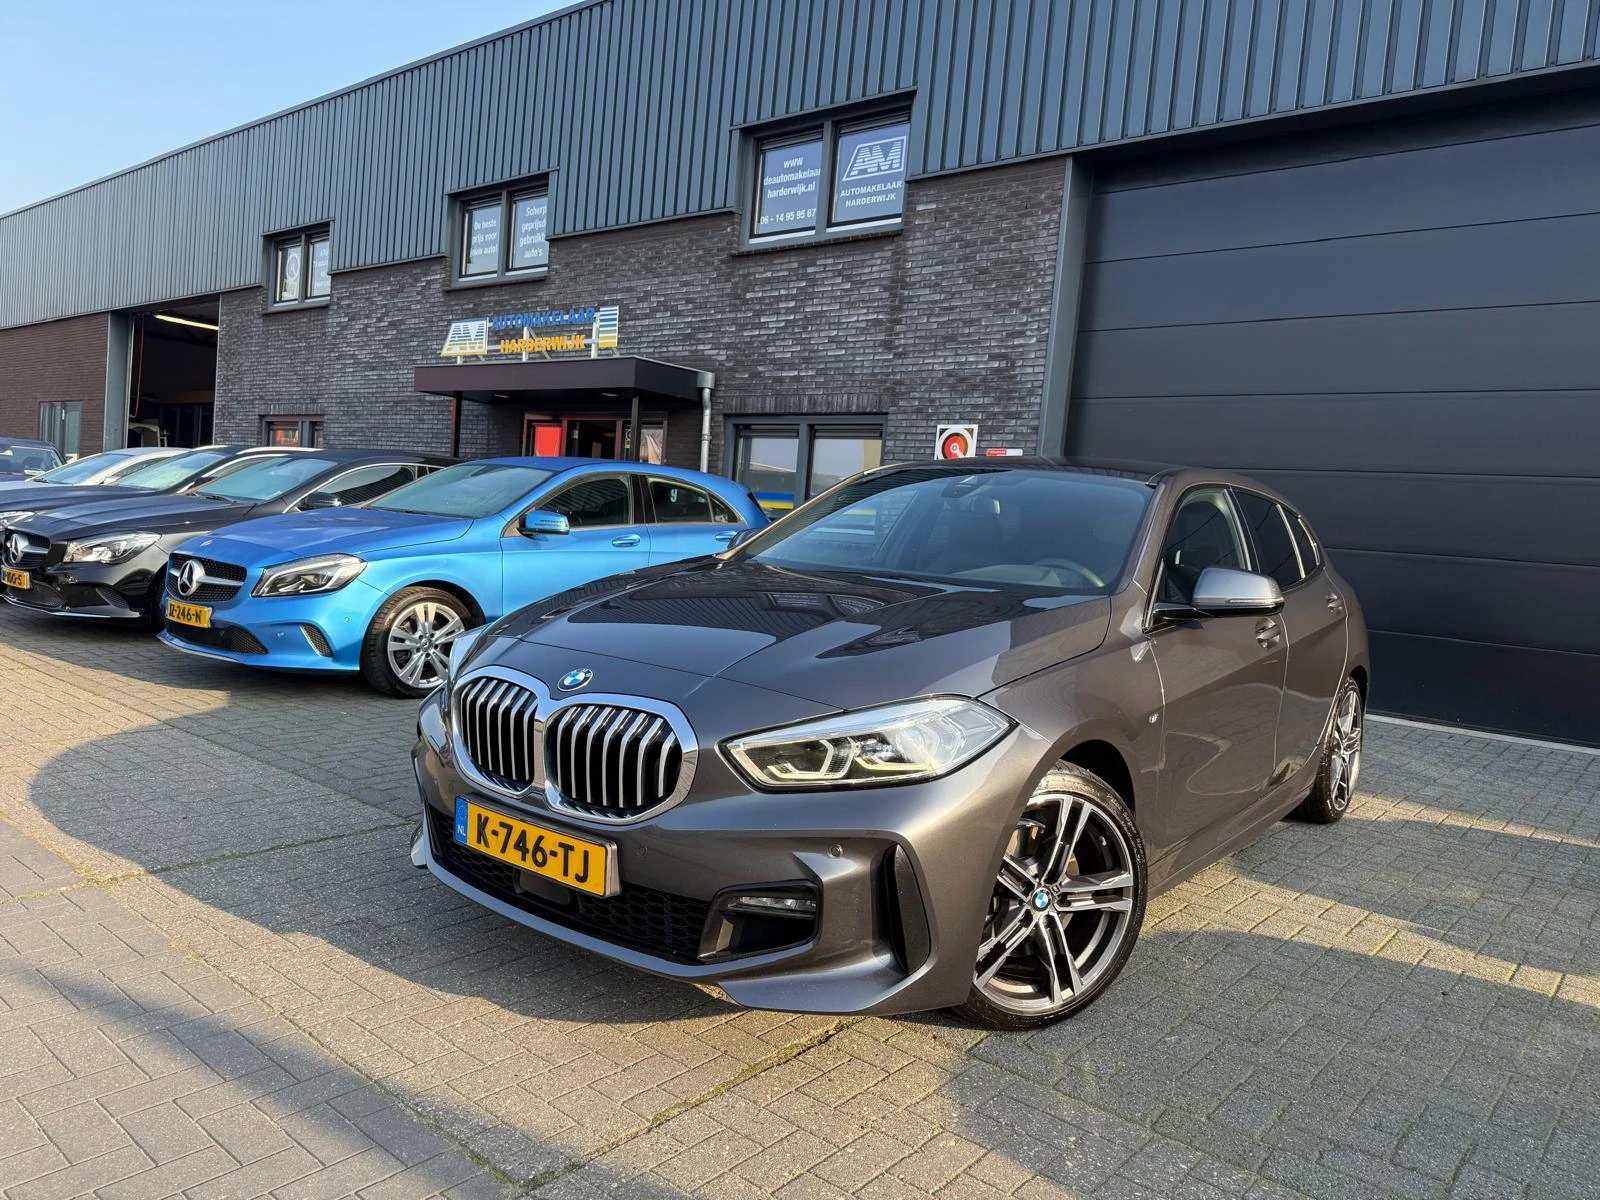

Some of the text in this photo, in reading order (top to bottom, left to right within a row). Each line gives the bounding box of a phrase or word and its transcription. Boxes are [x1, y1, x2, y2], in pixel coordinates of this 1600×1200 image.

[784, 157, 803, 168] www
[768, 181, 816, 198] harderwijk.nl
[840, 180, 903, 197] AUTOMAKELAAR
[845, 193, 896, 207] HARDERWIJK
[776, 213, 785, 223] 14
[796, 209, 806, 220] 95
[492, 306, 596, 331] AUTOMAKELAAR
[457, 823, 467, 837] NL
[476, 812, 590, 884] K-746-TJ
